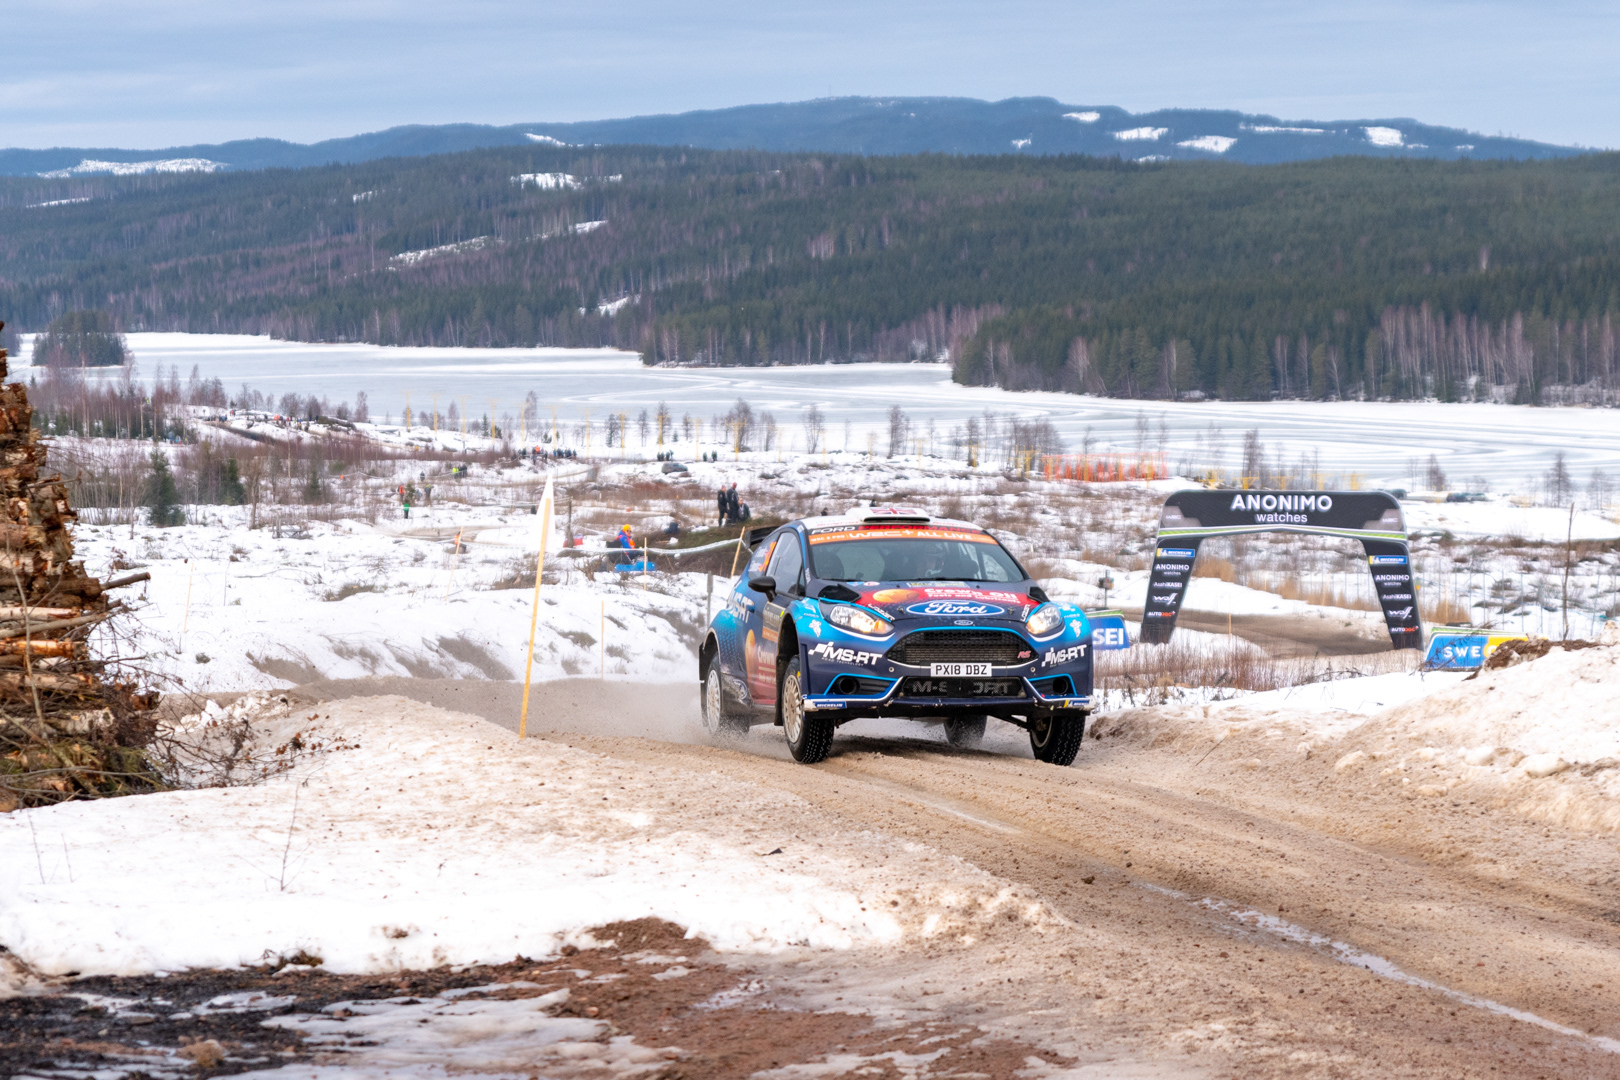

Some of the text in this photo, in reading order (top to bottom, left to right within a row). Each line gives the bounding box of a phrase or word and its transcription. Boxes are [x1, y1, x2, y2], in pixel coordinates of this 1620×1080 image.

[1231, 494, 1333, 511] ANONIMO
[1256, 512, 1308, 523] watches
[811, 526, 856, 535] FORD
[943, 532, 973, 540] LIVE
[1155, 563, 1190, 571] ANONIMO
[924, 588, 1018, 600] Crown Oil
[924, 600, 989, 615] Ford
[1092, 627, 1124, 645] SEI
[1018, 650, 1032, 659] RS
[935, 664, 988, 675] PX18 DBZ
[912, 680, 1013, 694] M-SORT
